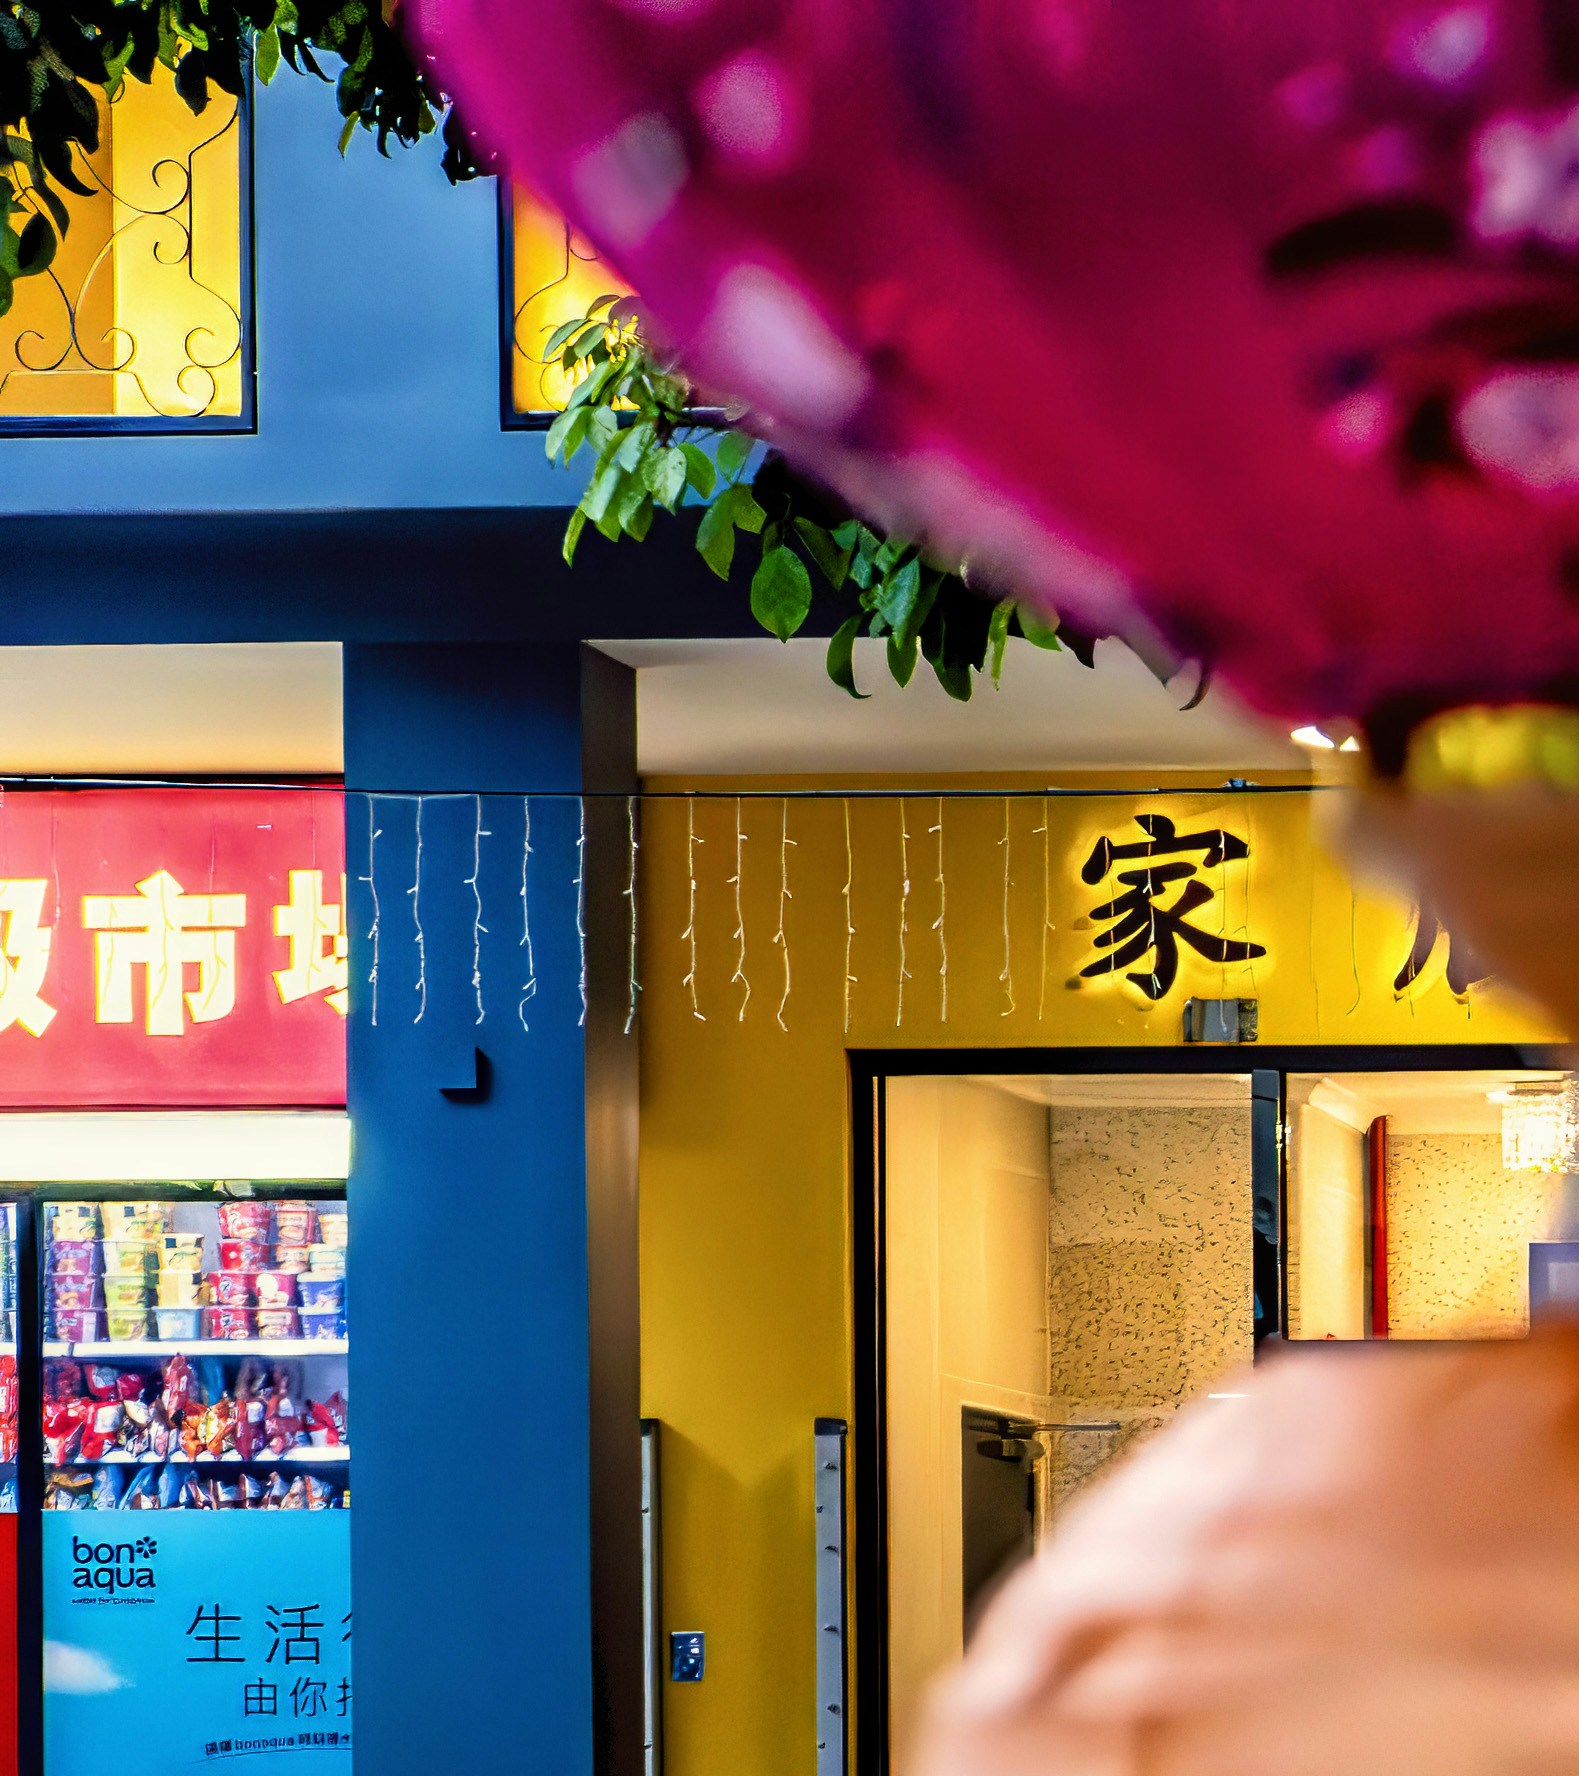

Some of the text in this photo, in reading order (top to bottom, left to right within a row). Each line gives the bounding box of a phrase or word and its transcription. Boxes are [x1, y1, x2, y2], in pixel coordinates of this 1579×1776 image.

[73, 1535, 135, 1564] bon
[72, 1567, 156, 1594] aqua
[186, 1603, 352, 1665] 生活
